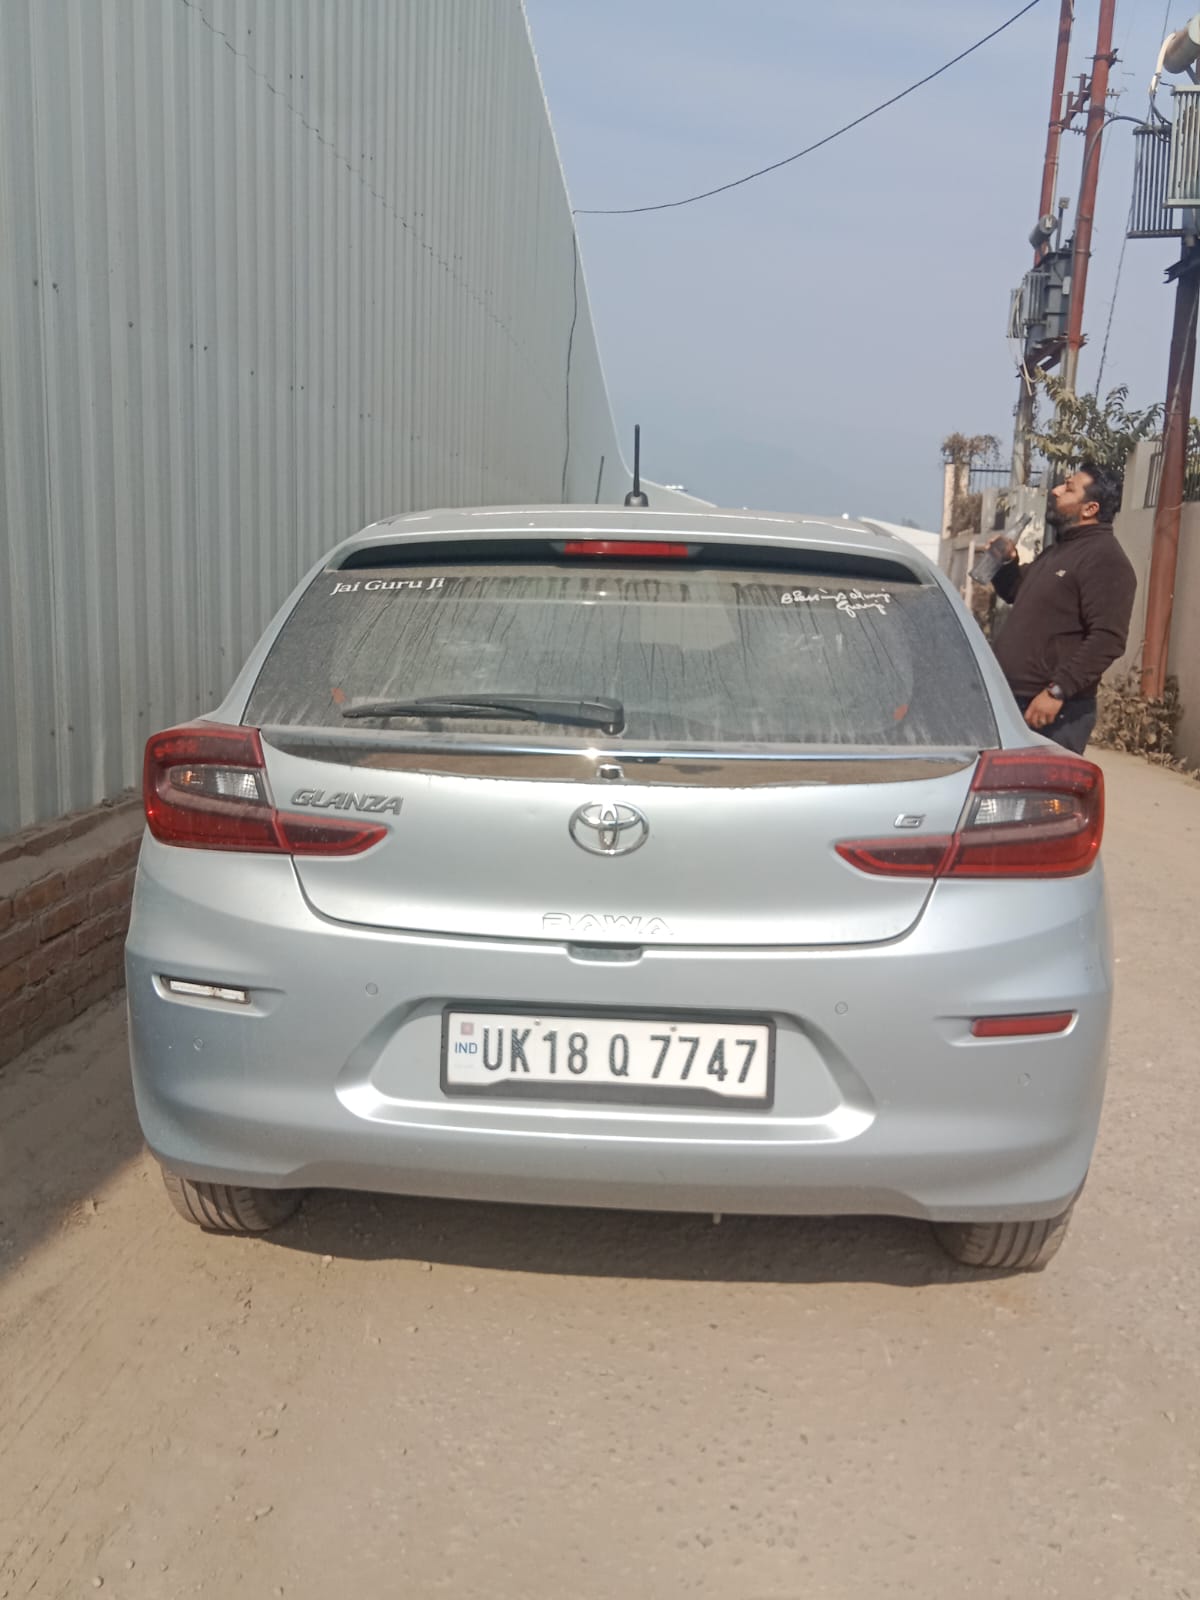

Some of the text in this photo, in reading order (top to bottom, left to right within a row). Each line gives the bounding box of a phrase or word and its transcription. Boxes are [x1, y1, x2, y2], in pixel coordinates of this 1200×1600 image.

[329, 577, 445, 596] Jai Guru Ji
[290, 788, 404, 815] GLANZA
[893, 813, 927, 829] G
[454, 1041, 478, 1055] IND
[608, 1033, 629, 1077] Q
[650, 1034, 757, 1083] 7747
